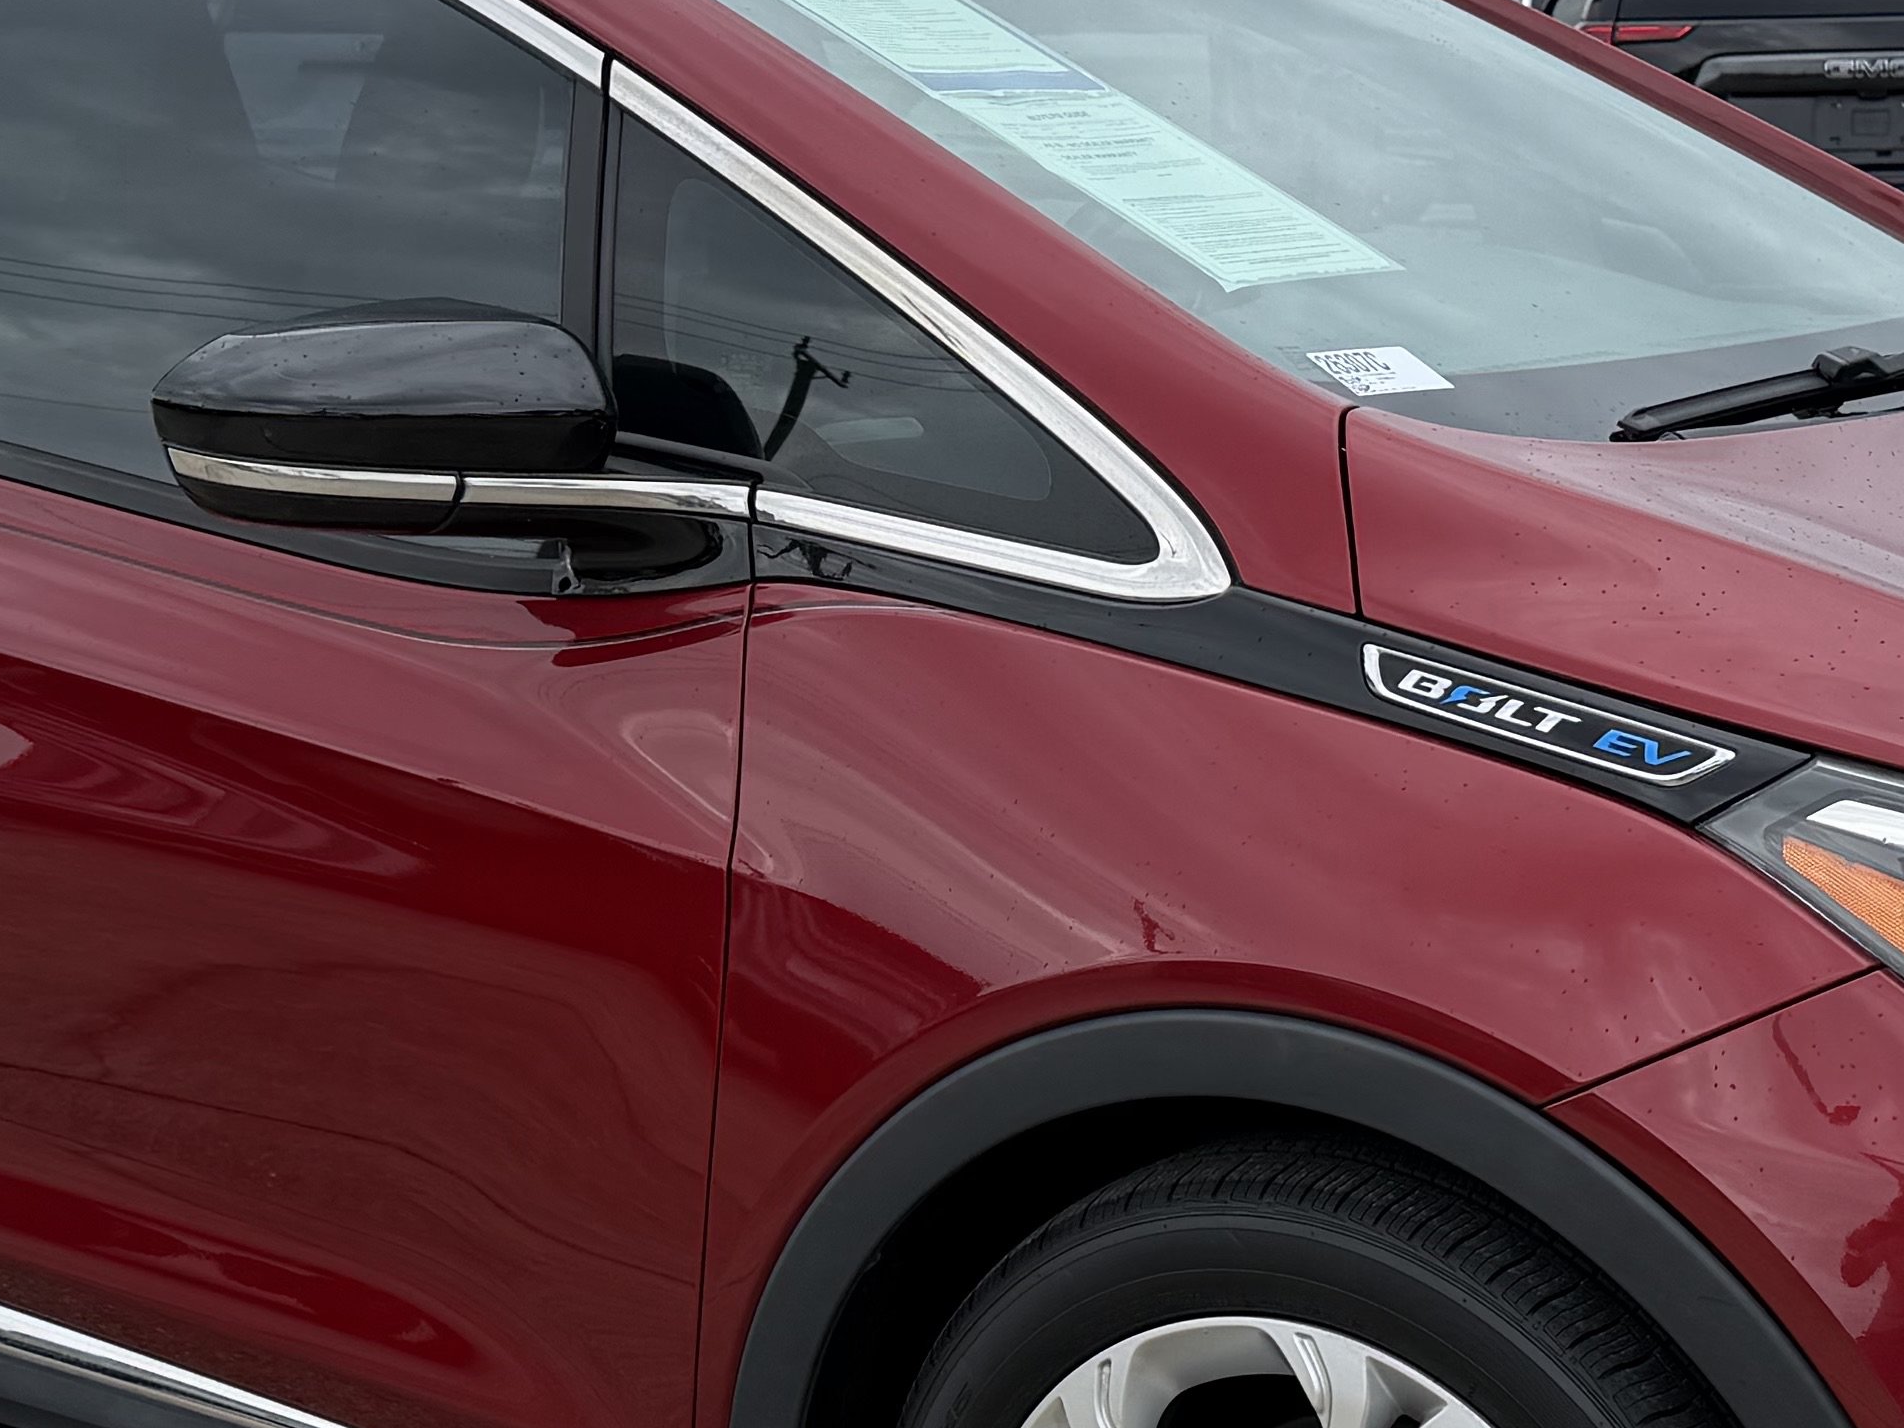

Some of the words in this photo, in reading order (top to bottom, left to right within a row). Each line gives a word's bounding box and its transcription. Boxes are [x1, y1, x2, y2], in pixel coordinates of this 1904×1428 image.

[1314, 351, 1391, 375] 26307C
[1397, 669, 1582, 734] BOLT
[1593, 729, 1691, 766] EV
